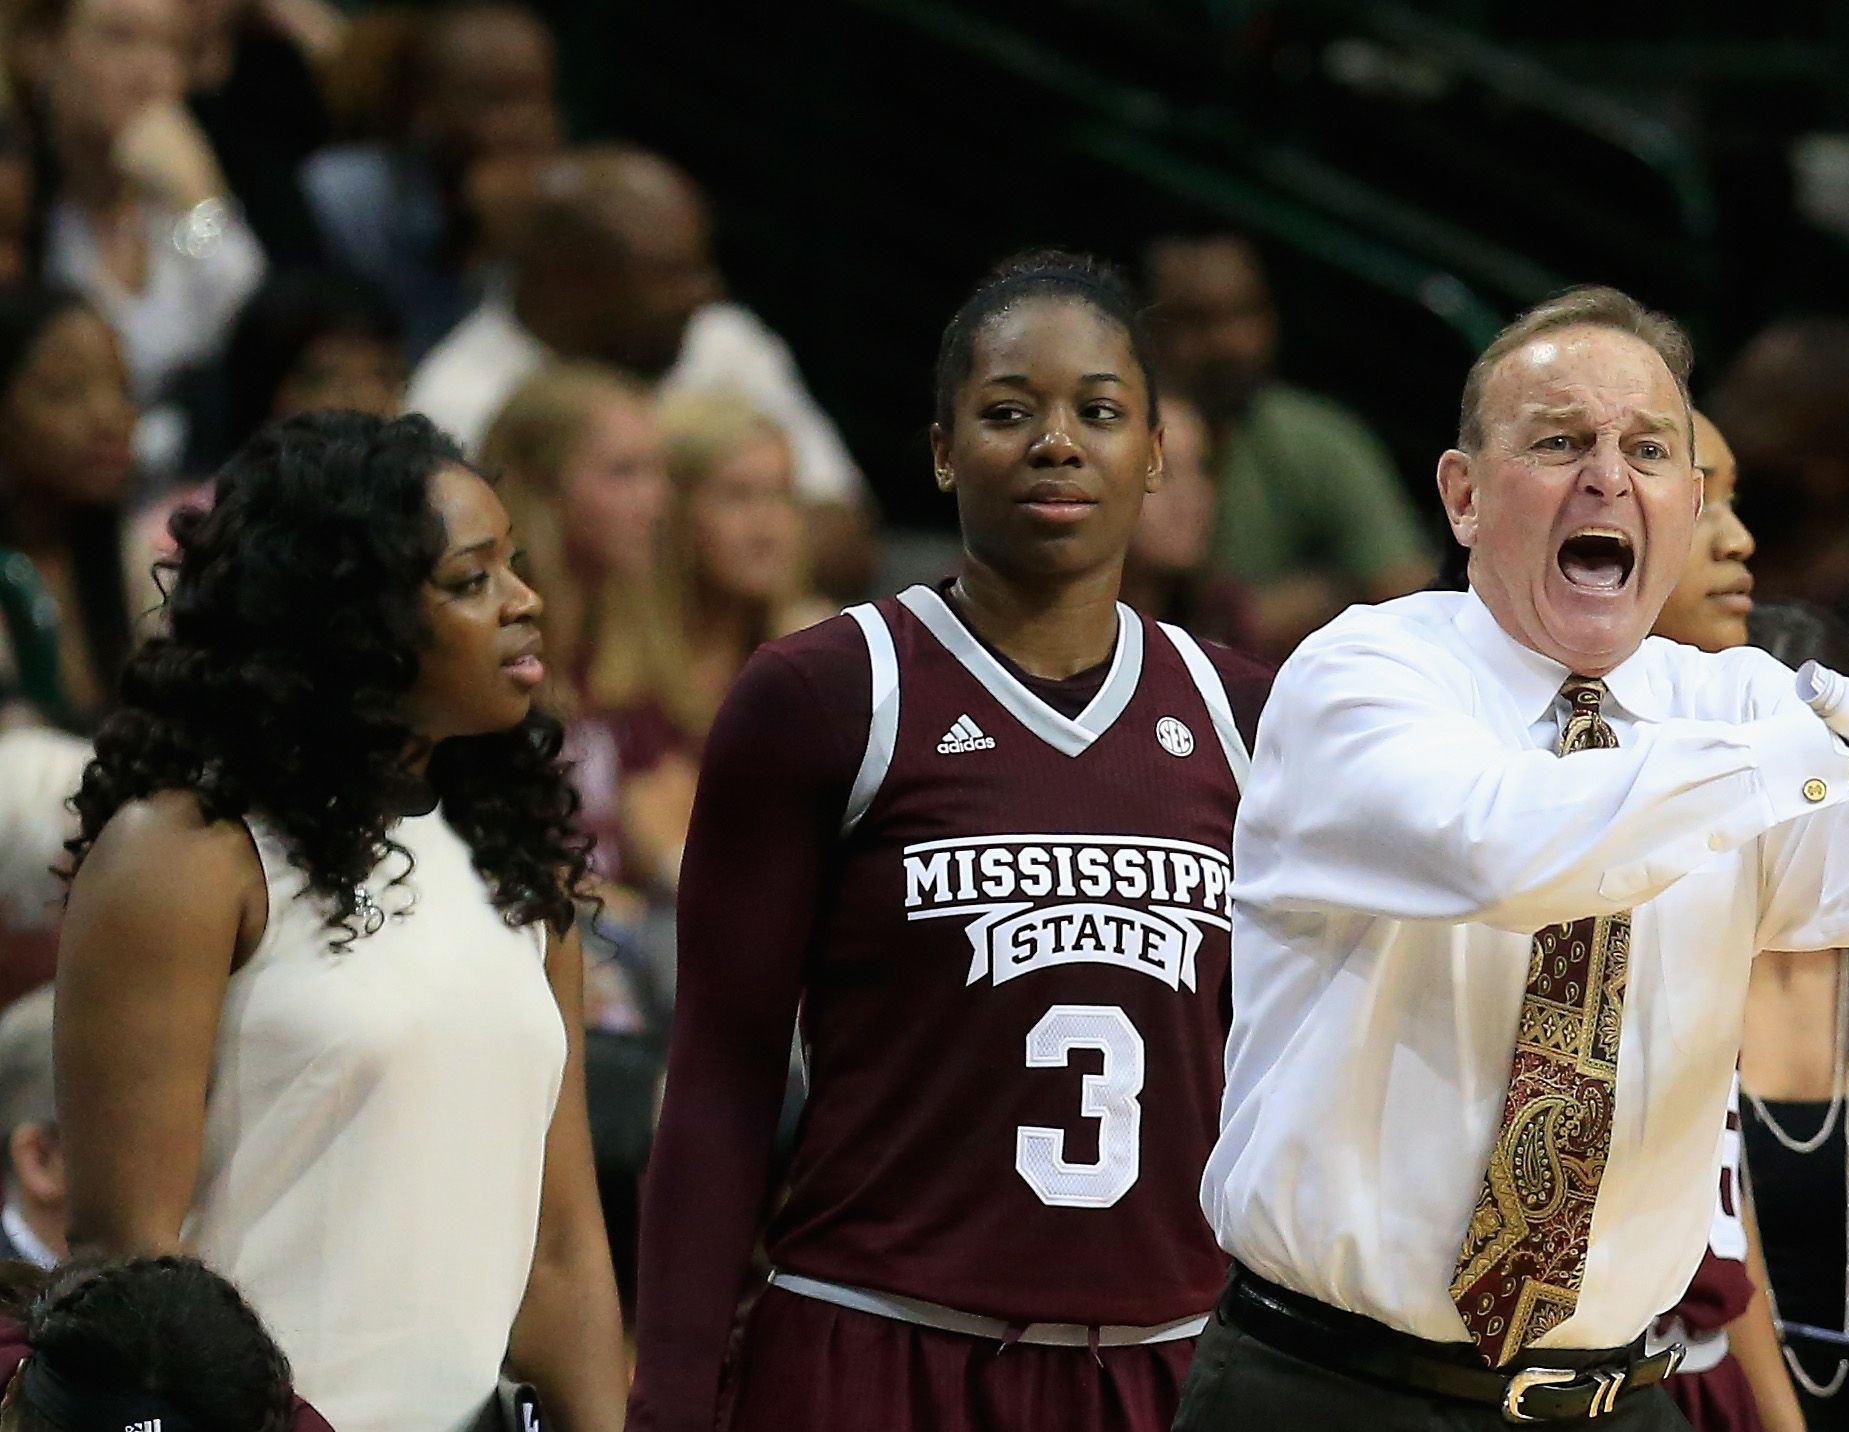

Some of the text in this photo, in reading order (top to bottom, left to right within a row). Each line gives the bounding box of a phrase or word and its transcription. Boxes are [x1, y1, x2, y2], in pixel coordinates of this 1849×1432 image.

[937, 737, 996, 754] adidas
[1158, 719, 1191, 753] SEC
[1010, 913, 1167, 970] STATE
[1015, 1005, 1144, 1208] 3
